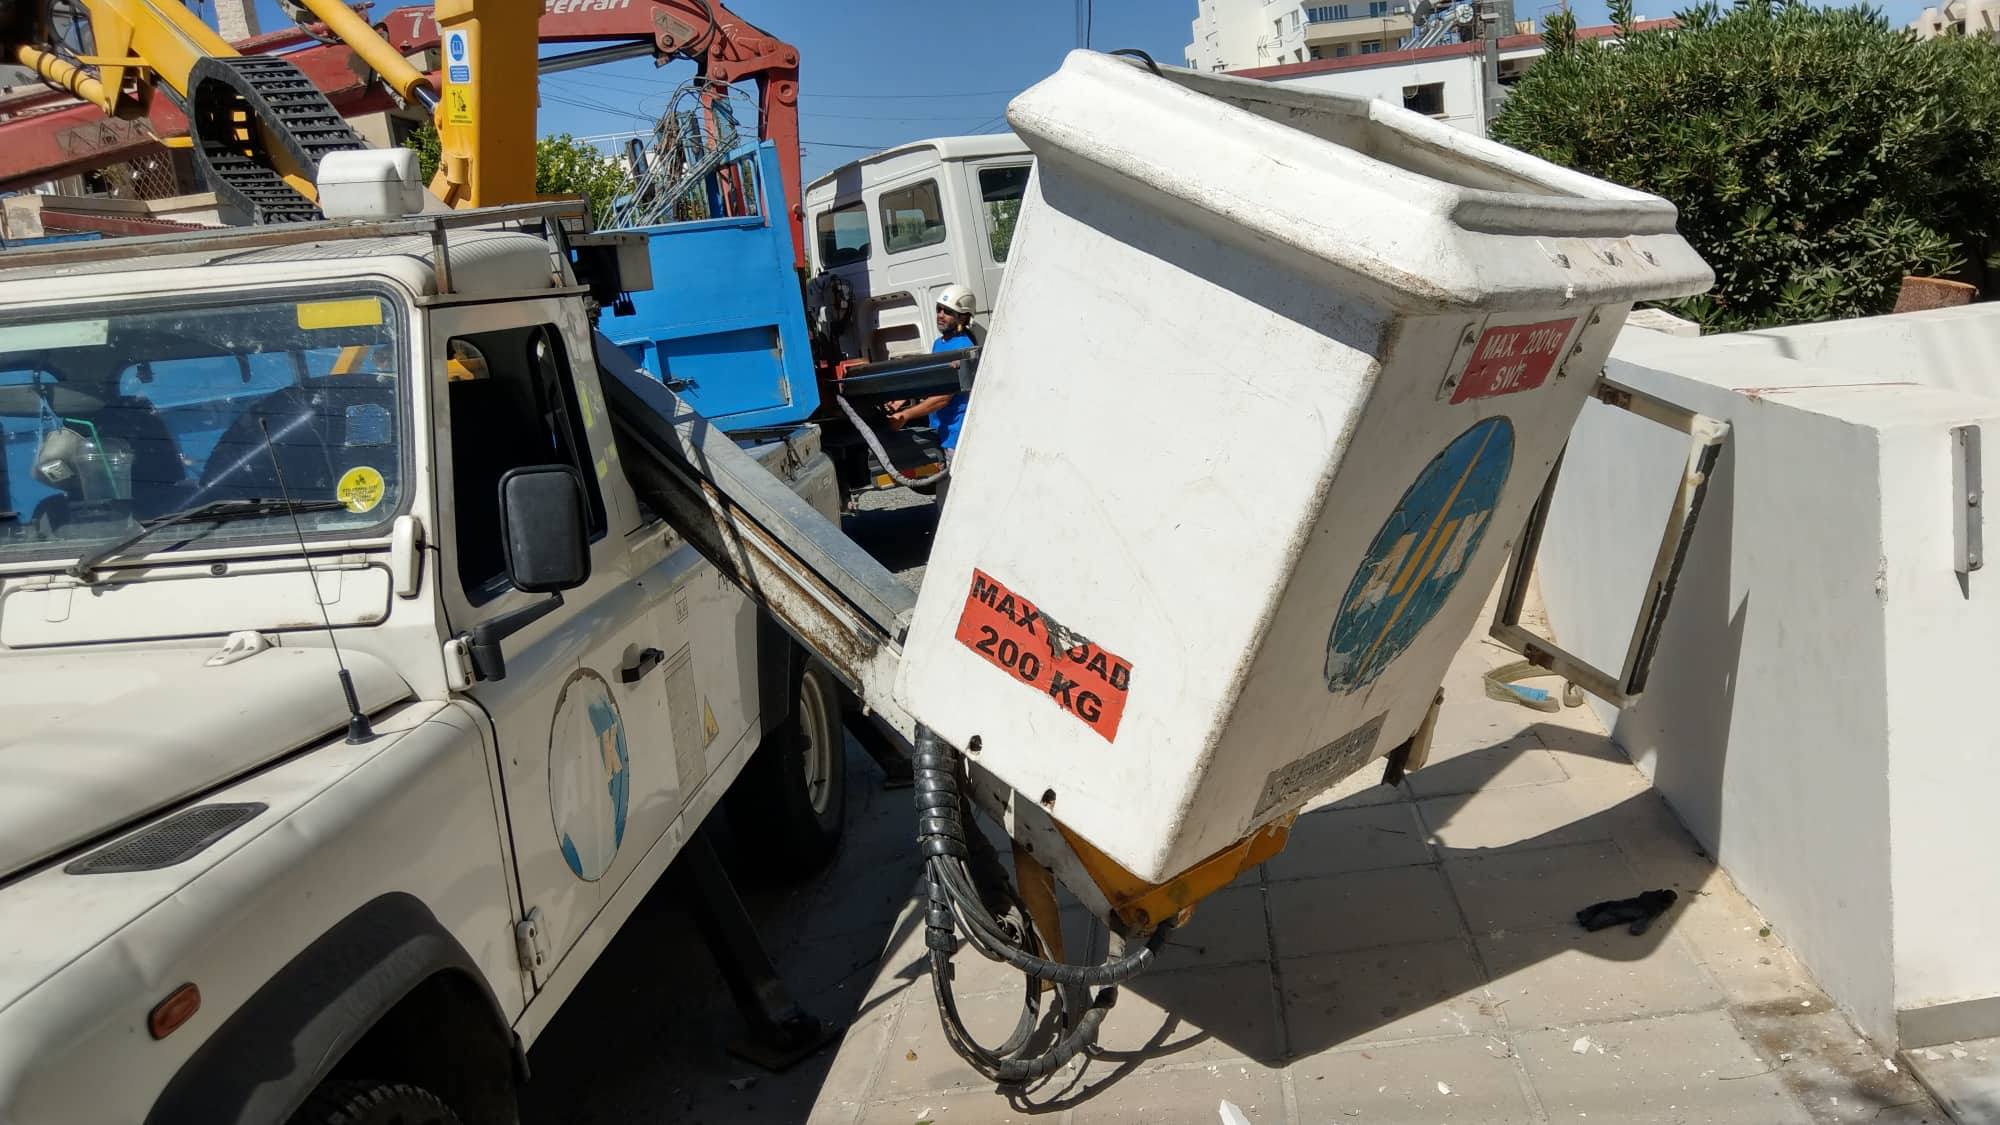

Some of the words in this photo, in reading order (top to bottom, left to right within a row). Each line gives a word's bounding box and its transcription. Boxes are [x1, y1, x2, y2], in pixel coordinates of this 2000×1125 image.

[972, 575, 1040, 636] MAX
[975, 625, 1041, 682] 200
[1050, 670, 1103, 724] KG
